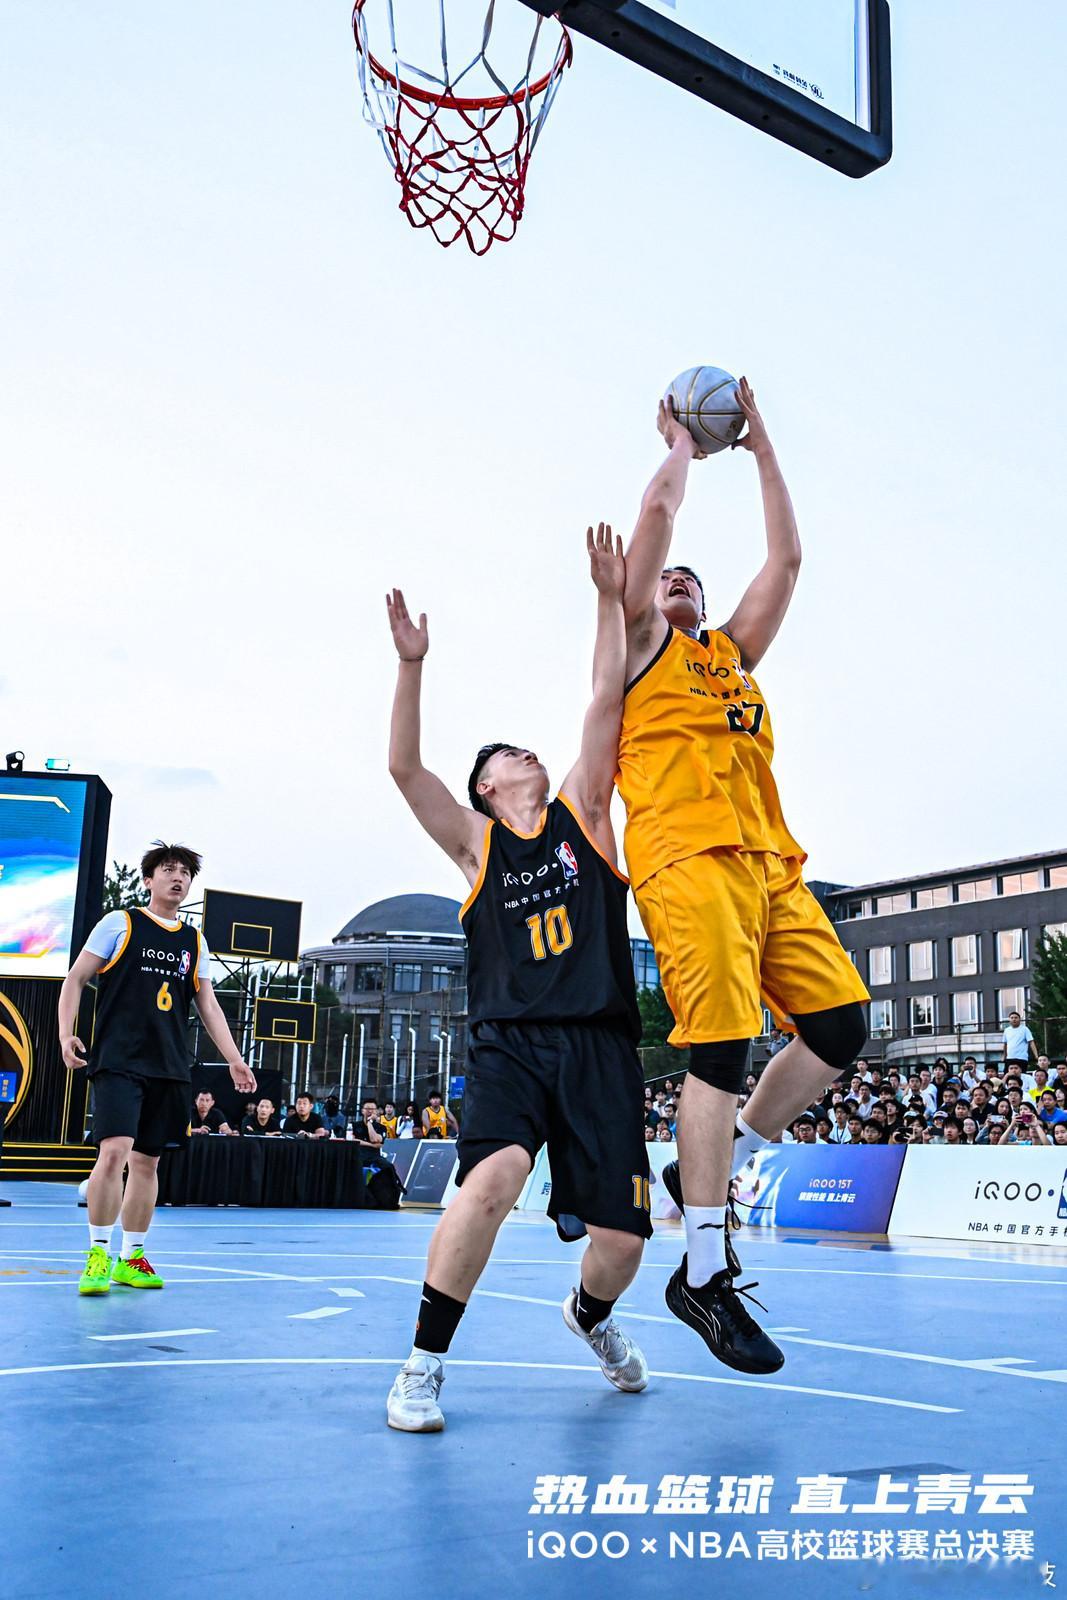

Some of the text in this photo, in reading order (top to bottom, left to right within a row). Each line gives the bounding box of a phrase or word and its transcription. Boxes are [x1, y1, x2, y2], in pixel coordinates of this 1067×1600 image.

[689, 687, 708, 697] NBA
[723, 700, 764, 737] 27
[502, 864, 549, 887] iQOO
[504, 901, 520, 910] NBA
[525, 904, 574, 961] 10
[142, 948, 175, 962] iQOO
[156, 981, 173, 1012] 6
[809, 1179, 853, 1189] iQOO 15T
[974, 1180, 1042, 1202] iQOO
[968, 1222, 989, 1232] NBA
